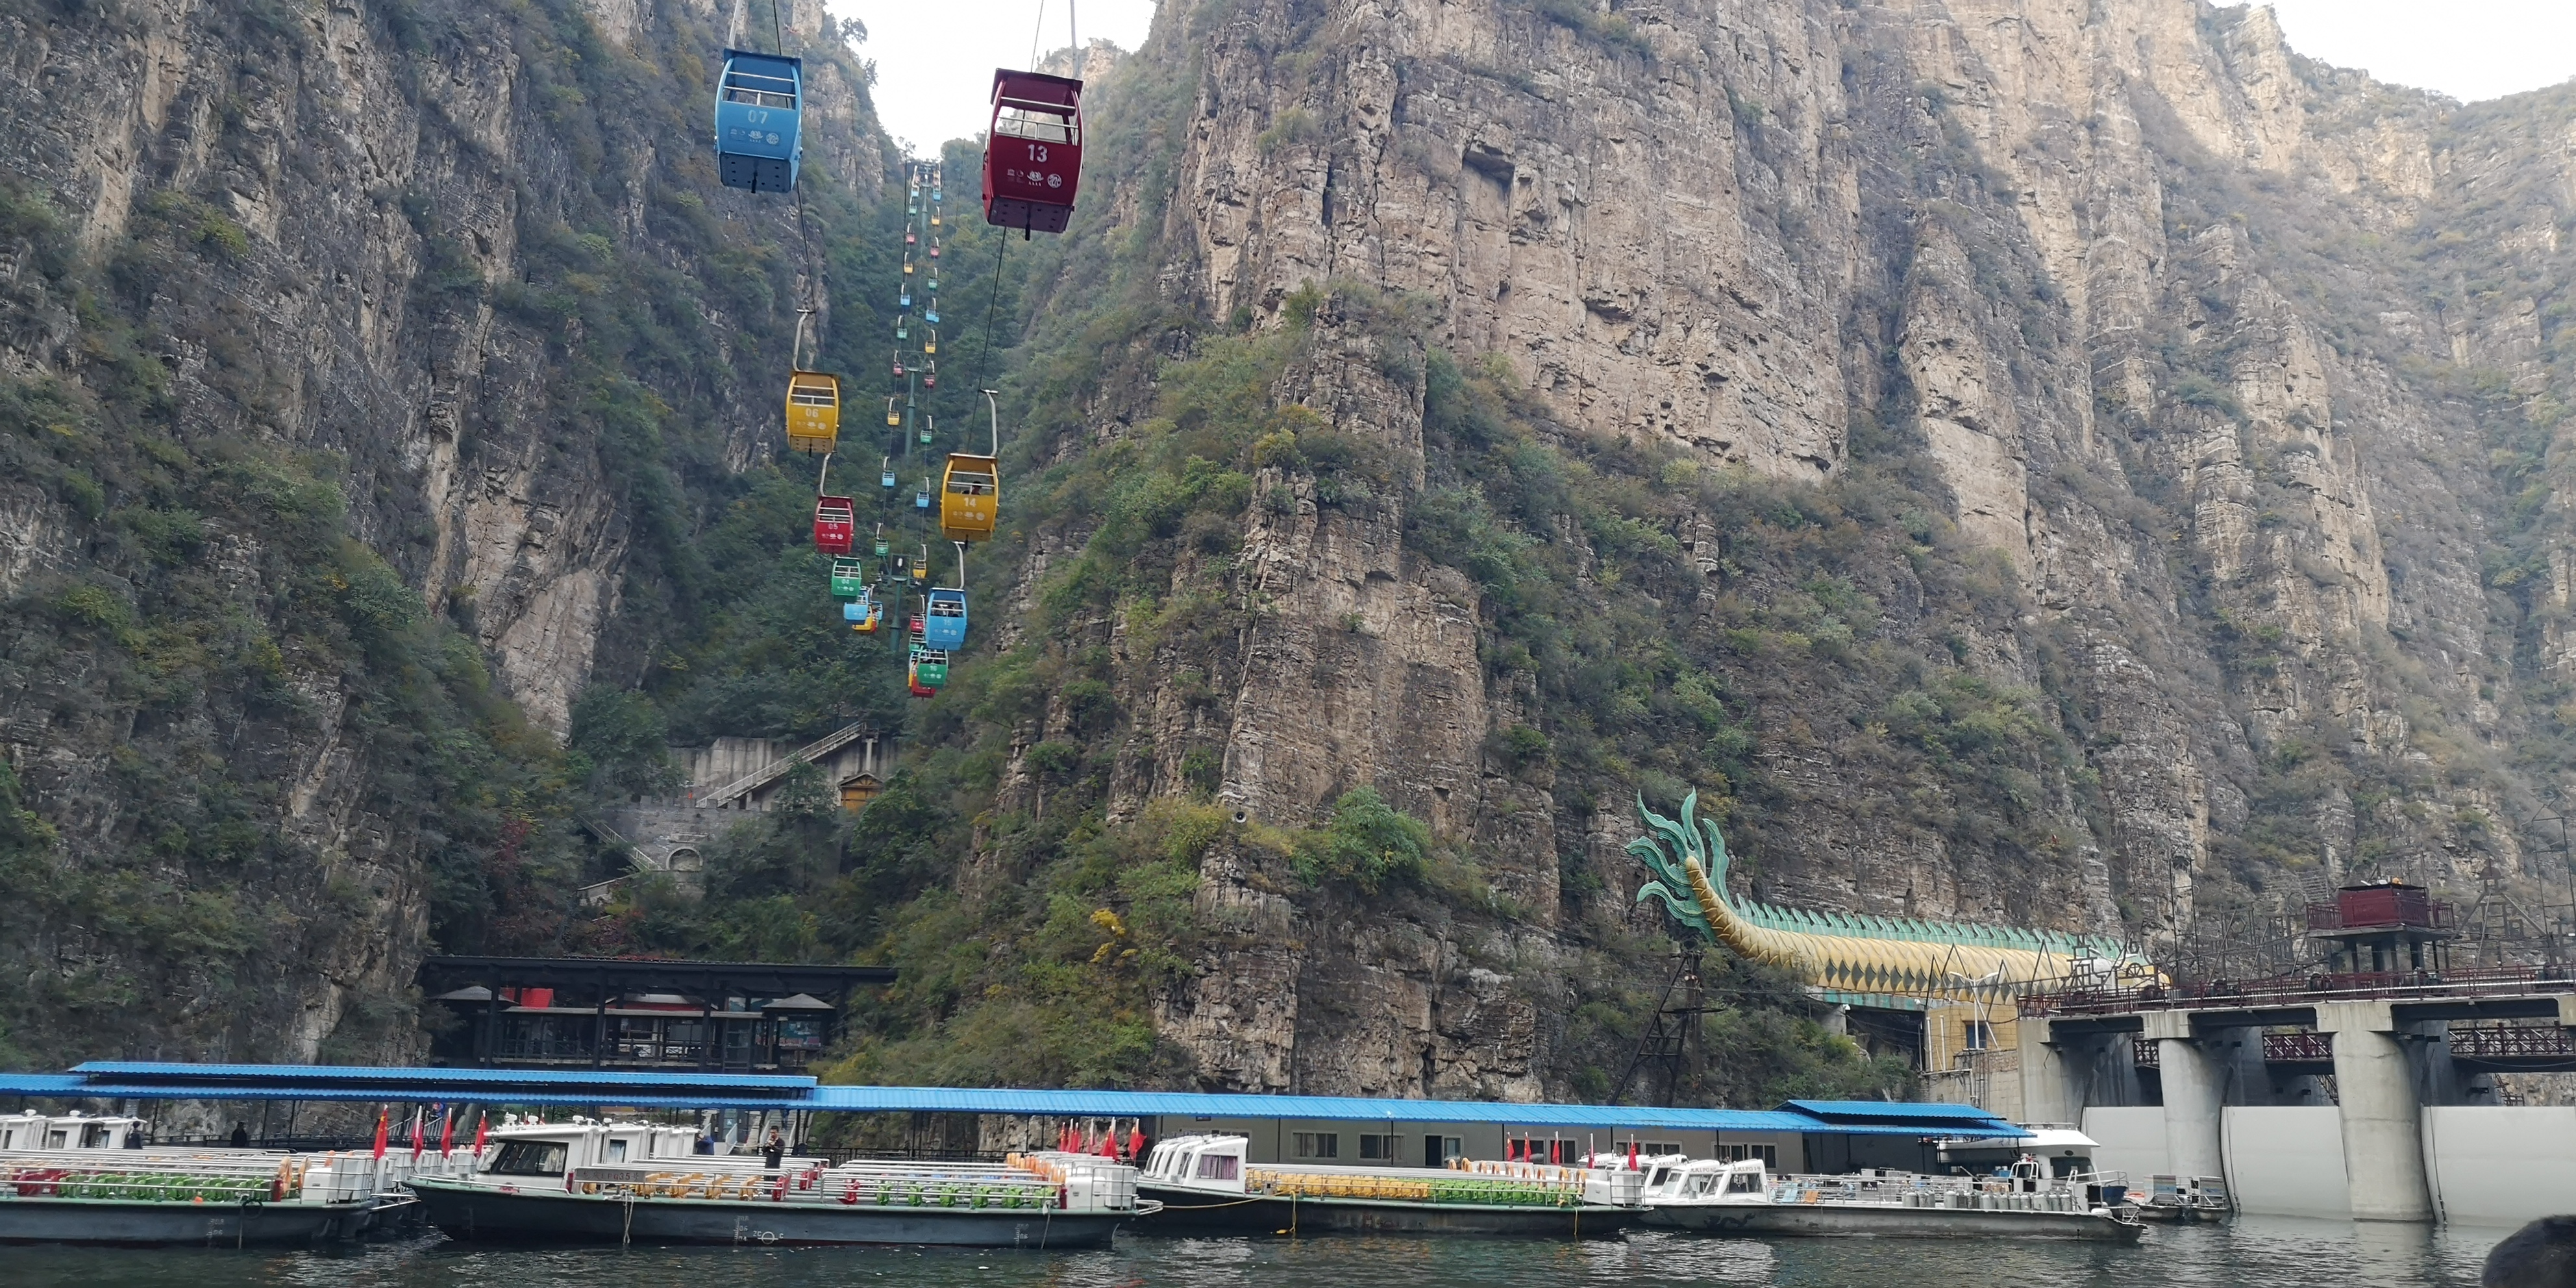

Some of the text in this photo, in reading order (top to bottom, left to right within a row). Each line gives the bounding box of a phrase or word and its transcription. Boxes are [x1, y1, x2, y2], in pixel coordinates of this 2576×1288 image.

[747, 110, 768, 124] 07
[1027, 143, 1048, 162] 13
[806, 408, 819, 417] 06
[963, 497, 976, 507] 14
